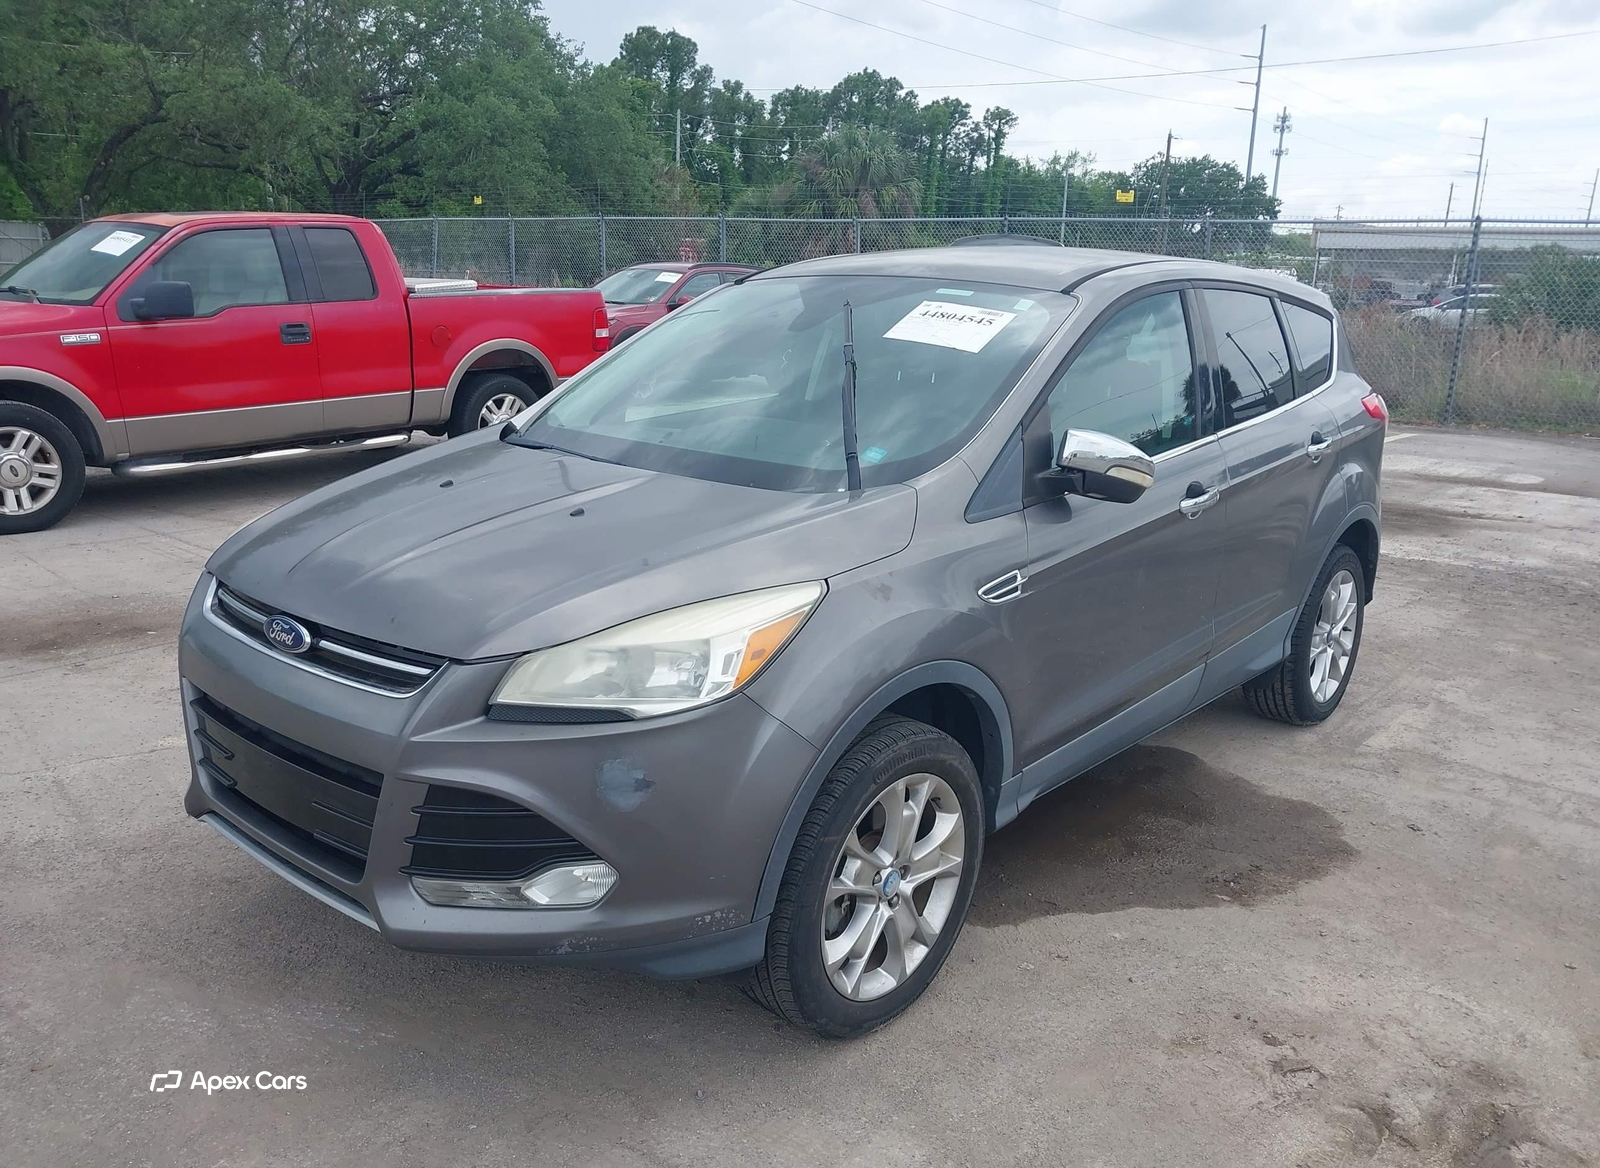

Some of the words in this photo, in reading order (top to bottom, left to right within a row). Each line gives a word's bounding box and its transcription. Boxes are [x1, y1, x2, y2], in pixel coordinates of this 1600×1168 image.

[918, 309, 997, 327] 44804545
[62, 334, 99, 343] F-150
[269, 619, 296, 646] Ford
